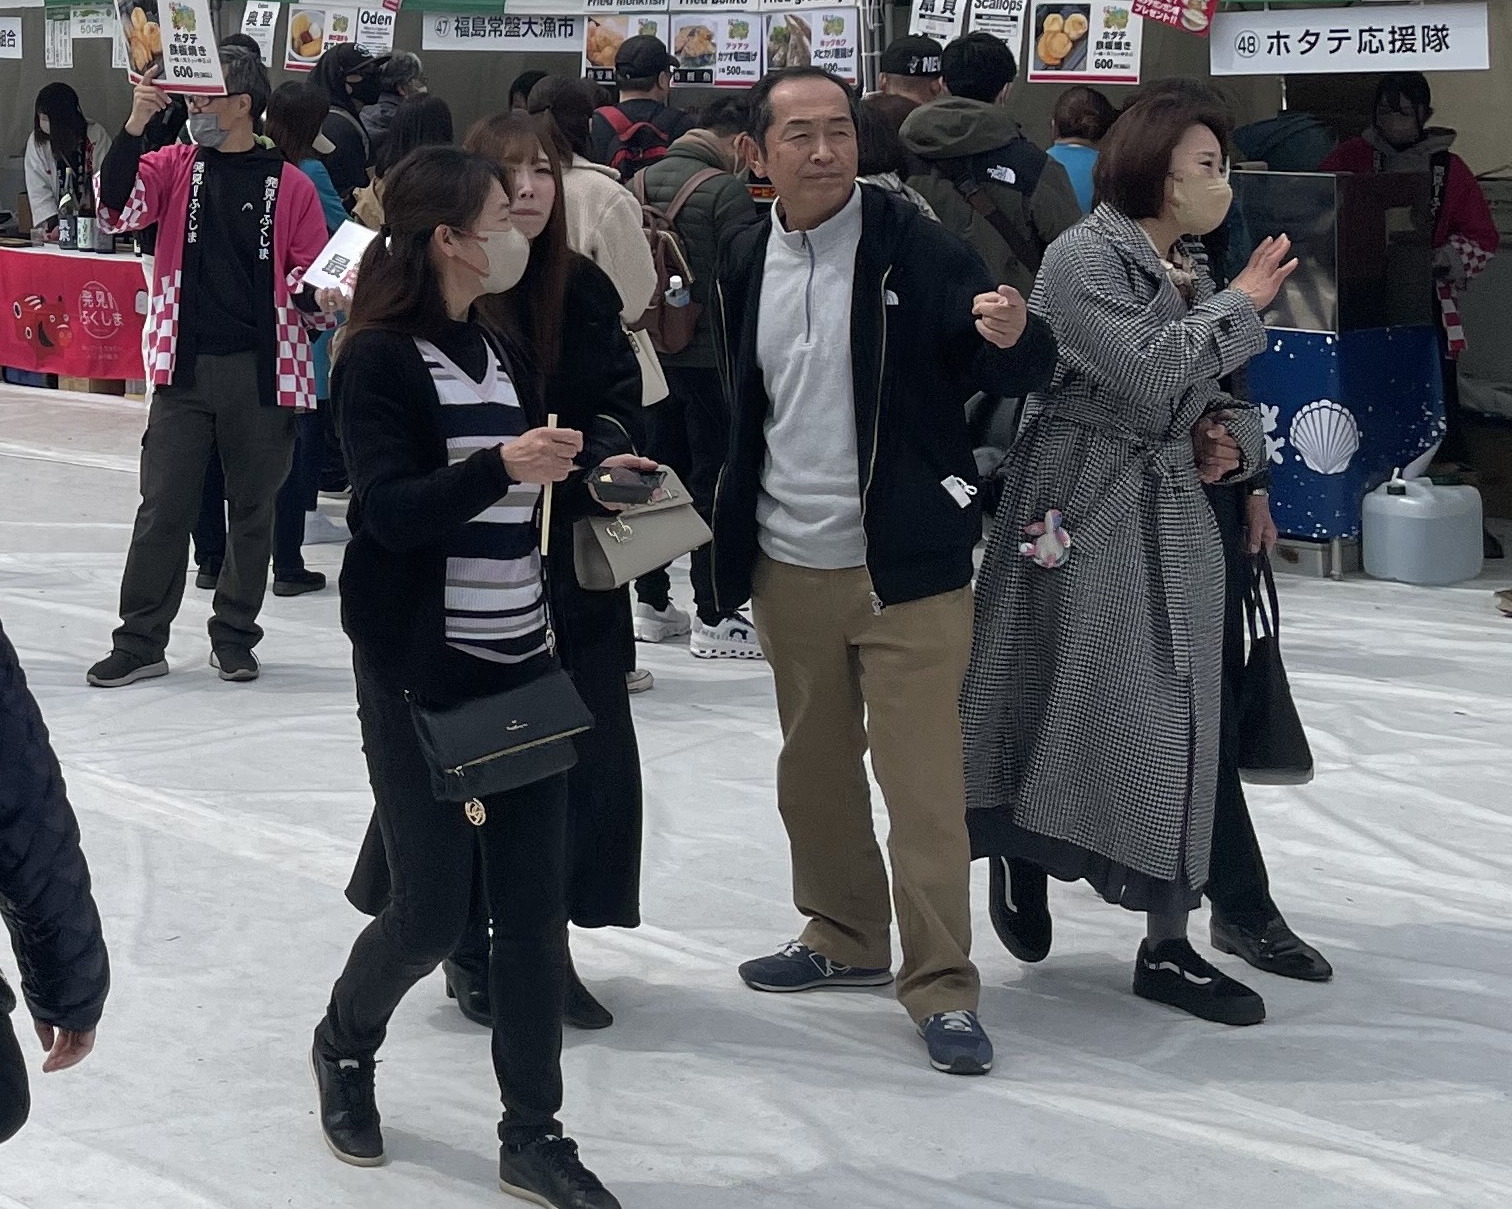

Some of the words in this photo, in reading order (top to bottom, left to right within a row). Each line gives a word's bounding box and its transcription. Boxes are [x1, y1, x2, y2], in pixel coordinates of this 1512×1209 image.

[361, 11, 392, 26] Oden
[174, 33, 198, 44] ホタテ
[1237, 33, 1258, 56] 48
[1266, 25, 1451, 56] ホタテ応援隊
[80, 312, 124, 326] ふくしま
